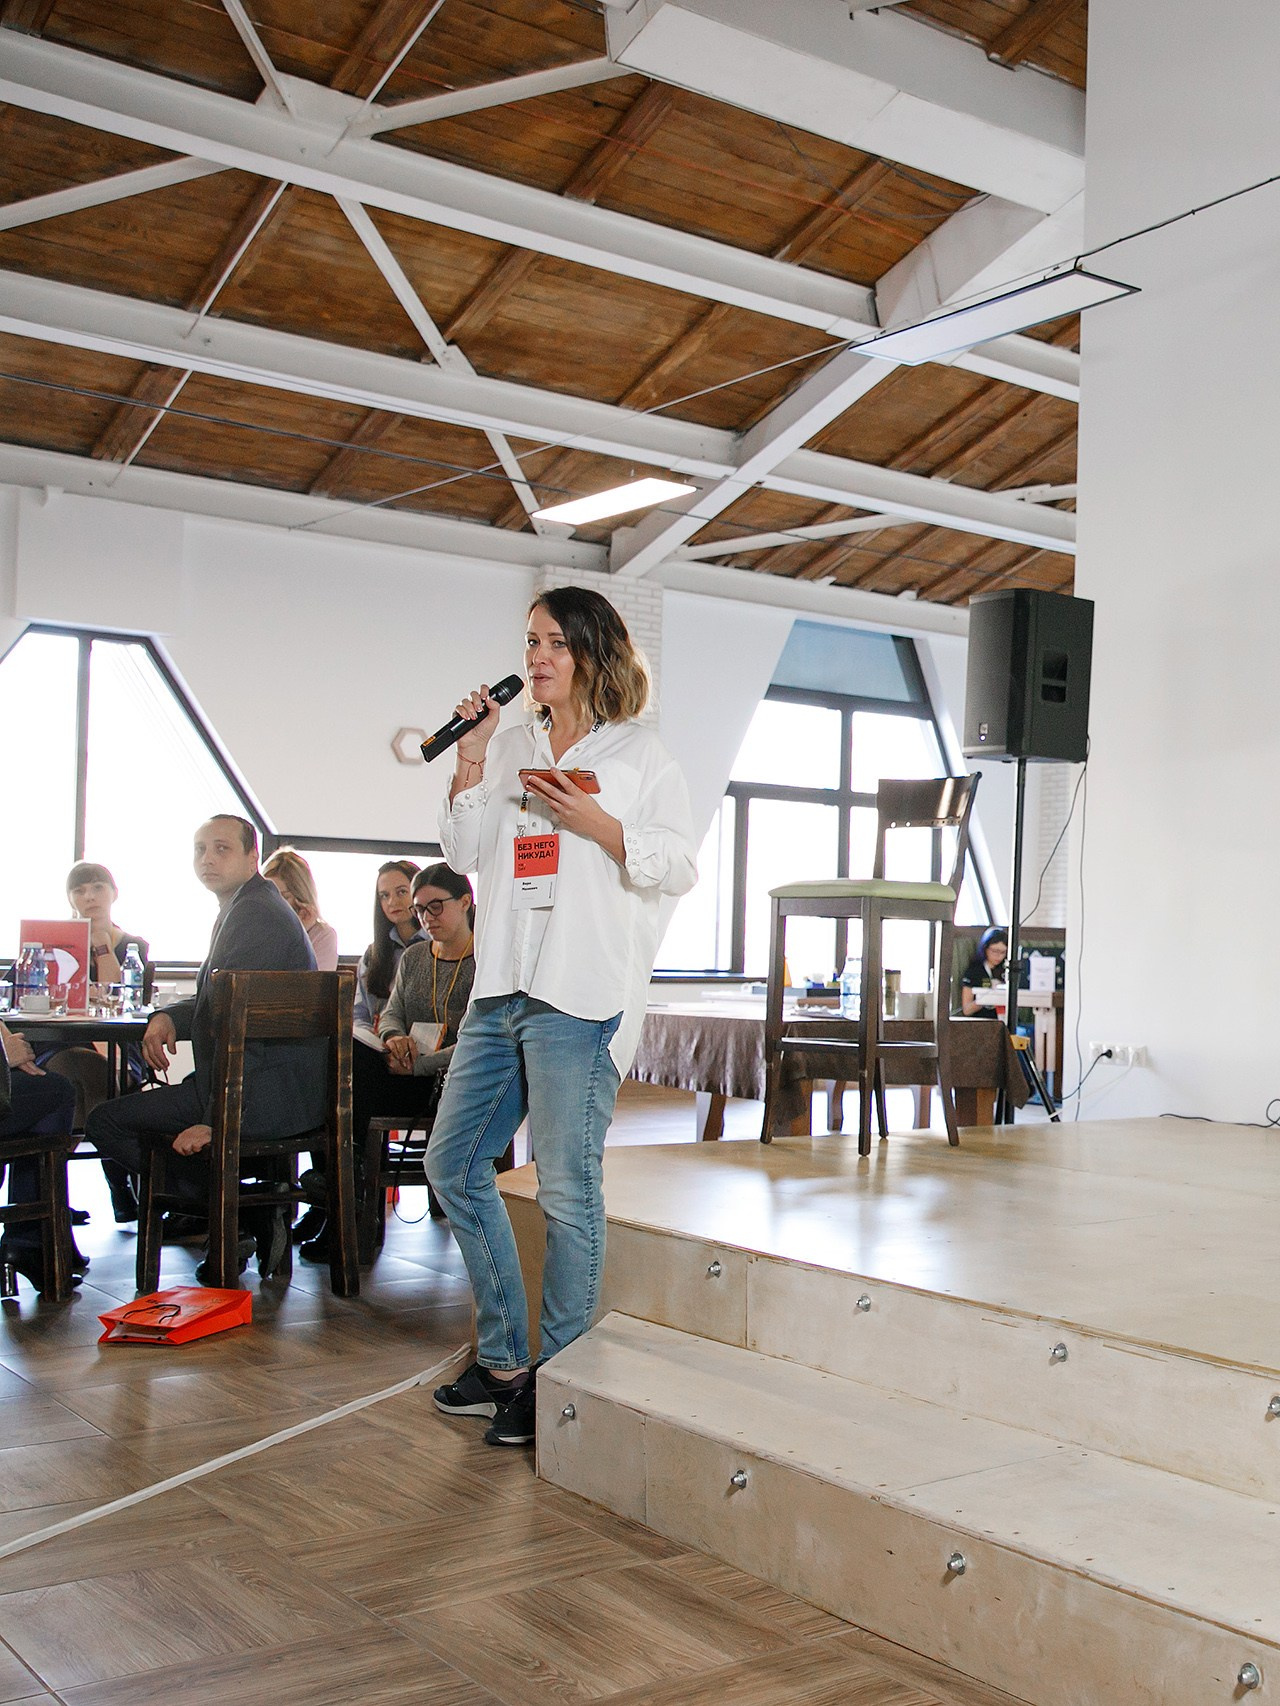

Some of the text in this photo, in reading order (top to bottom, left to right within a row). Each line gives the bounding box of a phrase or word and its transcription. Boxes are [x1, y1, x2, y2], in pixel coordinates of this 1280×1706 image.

[518, 841, 555, 851] БЕЗ НЕГО
[518, 850, 554, 860] НИКУДА!
